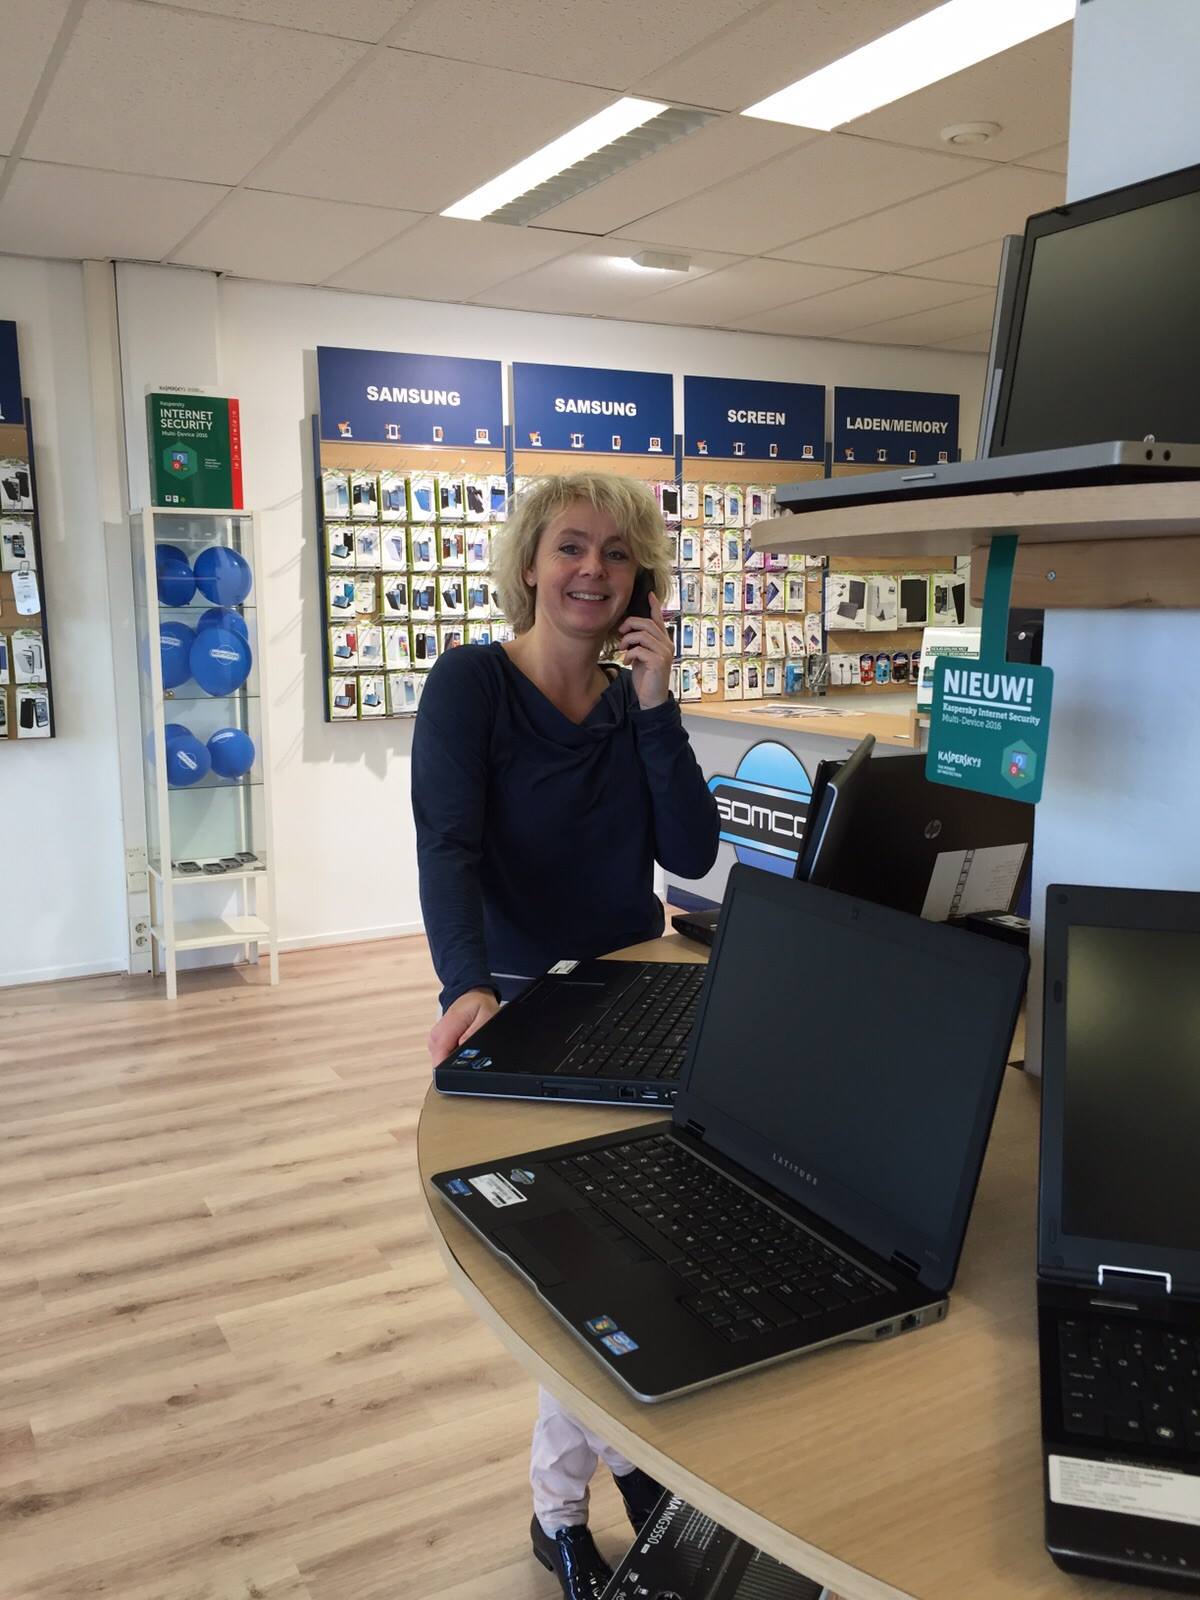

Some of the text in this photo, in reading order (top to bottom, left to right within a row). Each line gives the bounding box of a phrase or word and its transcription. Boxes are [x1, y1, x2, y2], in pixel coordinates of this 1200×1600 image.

[366, 385, 461, 406] SAMSUNG
[160, 409, 214, 421] INTERNET
[554, 398, 637, 417] SAMSUNG
[160, 418, 213, 430] SECURITY
[727, 409, 786, 426] SCREEN
[846, 416, 948, 434] LADEN/MEMORY
[943, 668, 1034, 704] NIEUW!
[942, 702, 1041, 727] Kaspersky Internet Security
[942, 713, 1003, 731] Multi-Device 2016
[647, 1510, 676, 1545] MG3550
